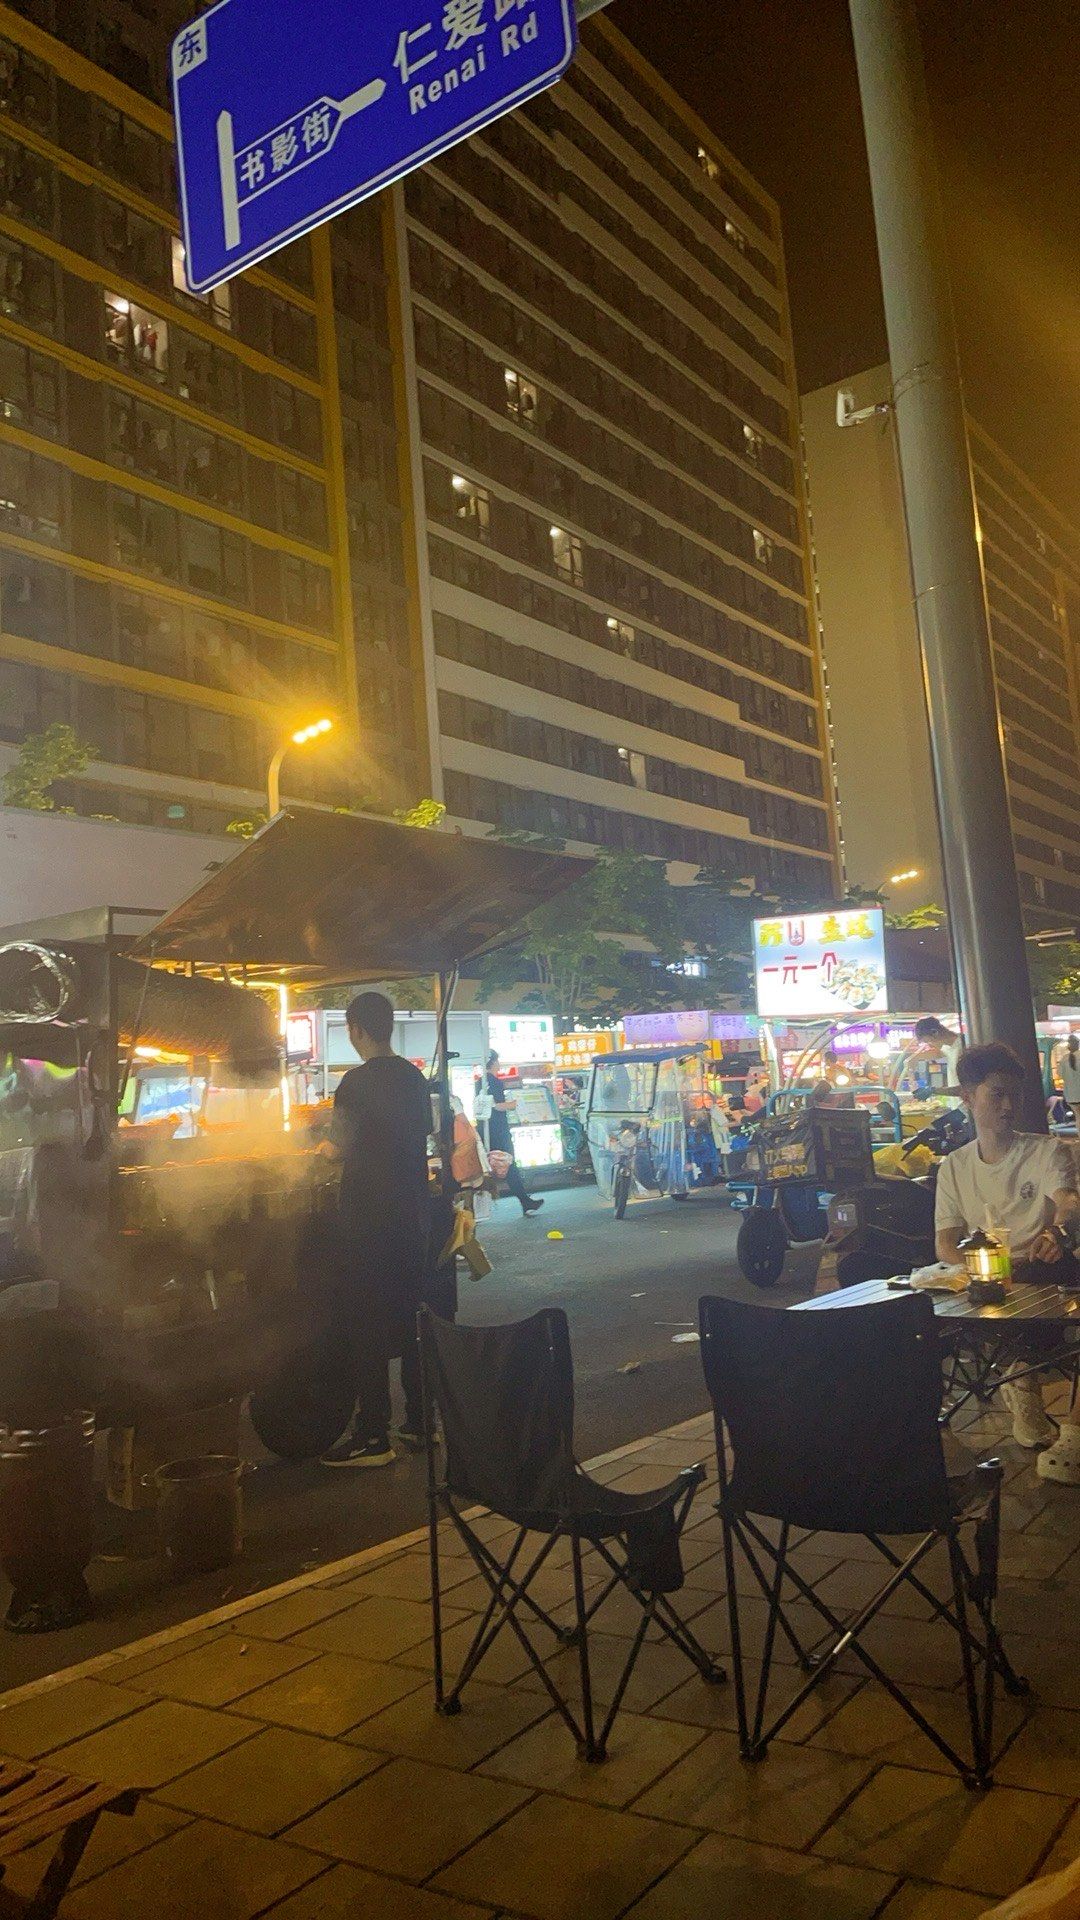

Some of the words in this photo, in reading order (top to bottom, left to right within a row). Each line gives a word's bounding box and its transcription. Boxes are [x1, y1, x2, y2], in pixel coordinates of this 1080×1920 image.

[178, 29, 202, 67] 东
[409, 44, 486, 115] Renai
[501, 11, 539, 57] Rd
[241, 105, 331, 189] 书影街
[763, 952, 837, 984] 一元一个
